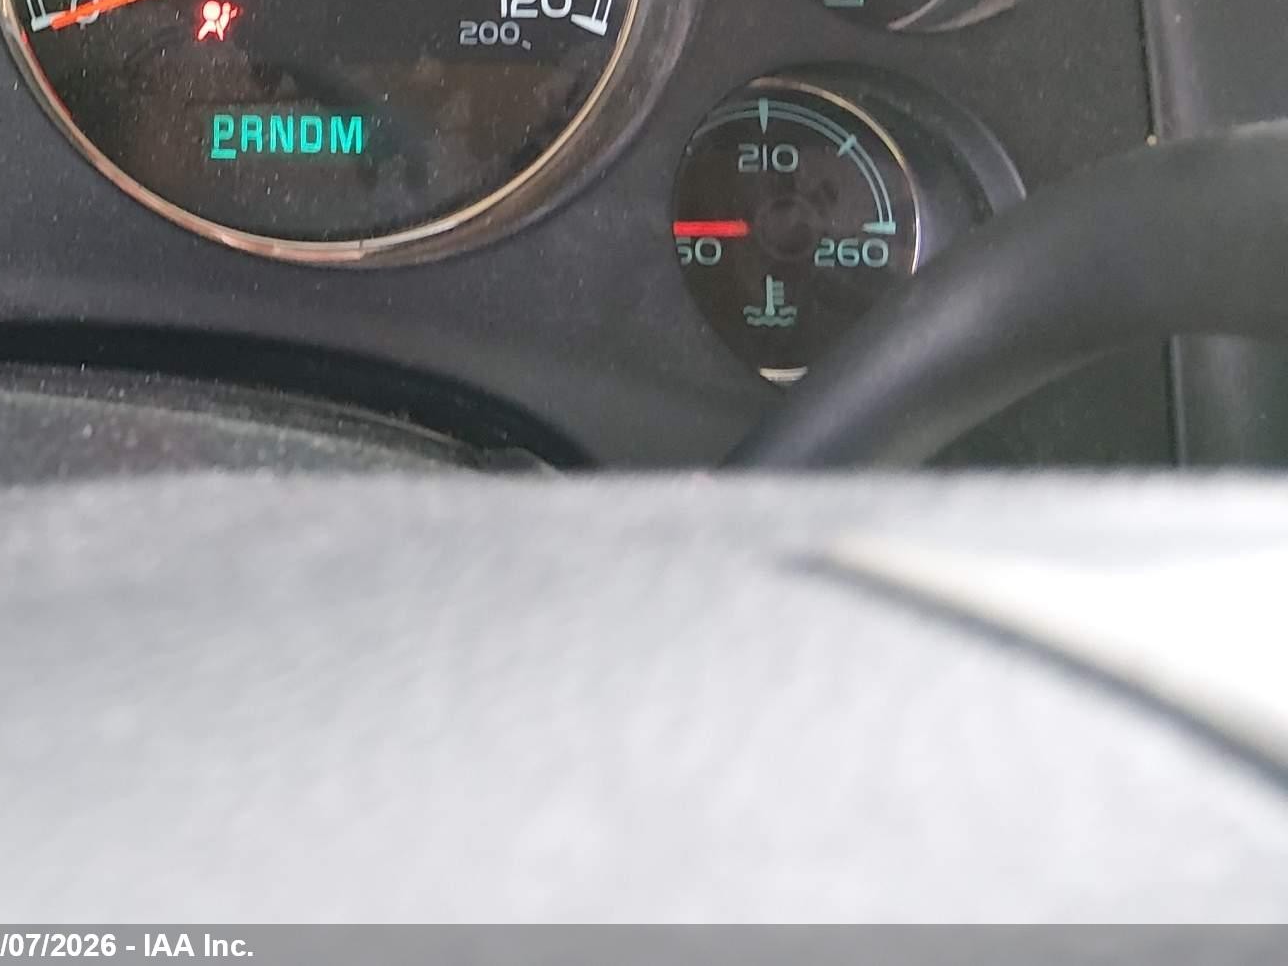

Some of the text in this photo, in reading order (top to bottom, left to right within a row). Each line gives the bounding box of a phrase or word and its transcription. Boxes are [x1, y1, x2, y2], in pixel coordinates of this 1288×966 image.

[459, 20, 521, 46] 200
[738, 143, 799, 172] 210
[814, 237, 889, 267] 260
